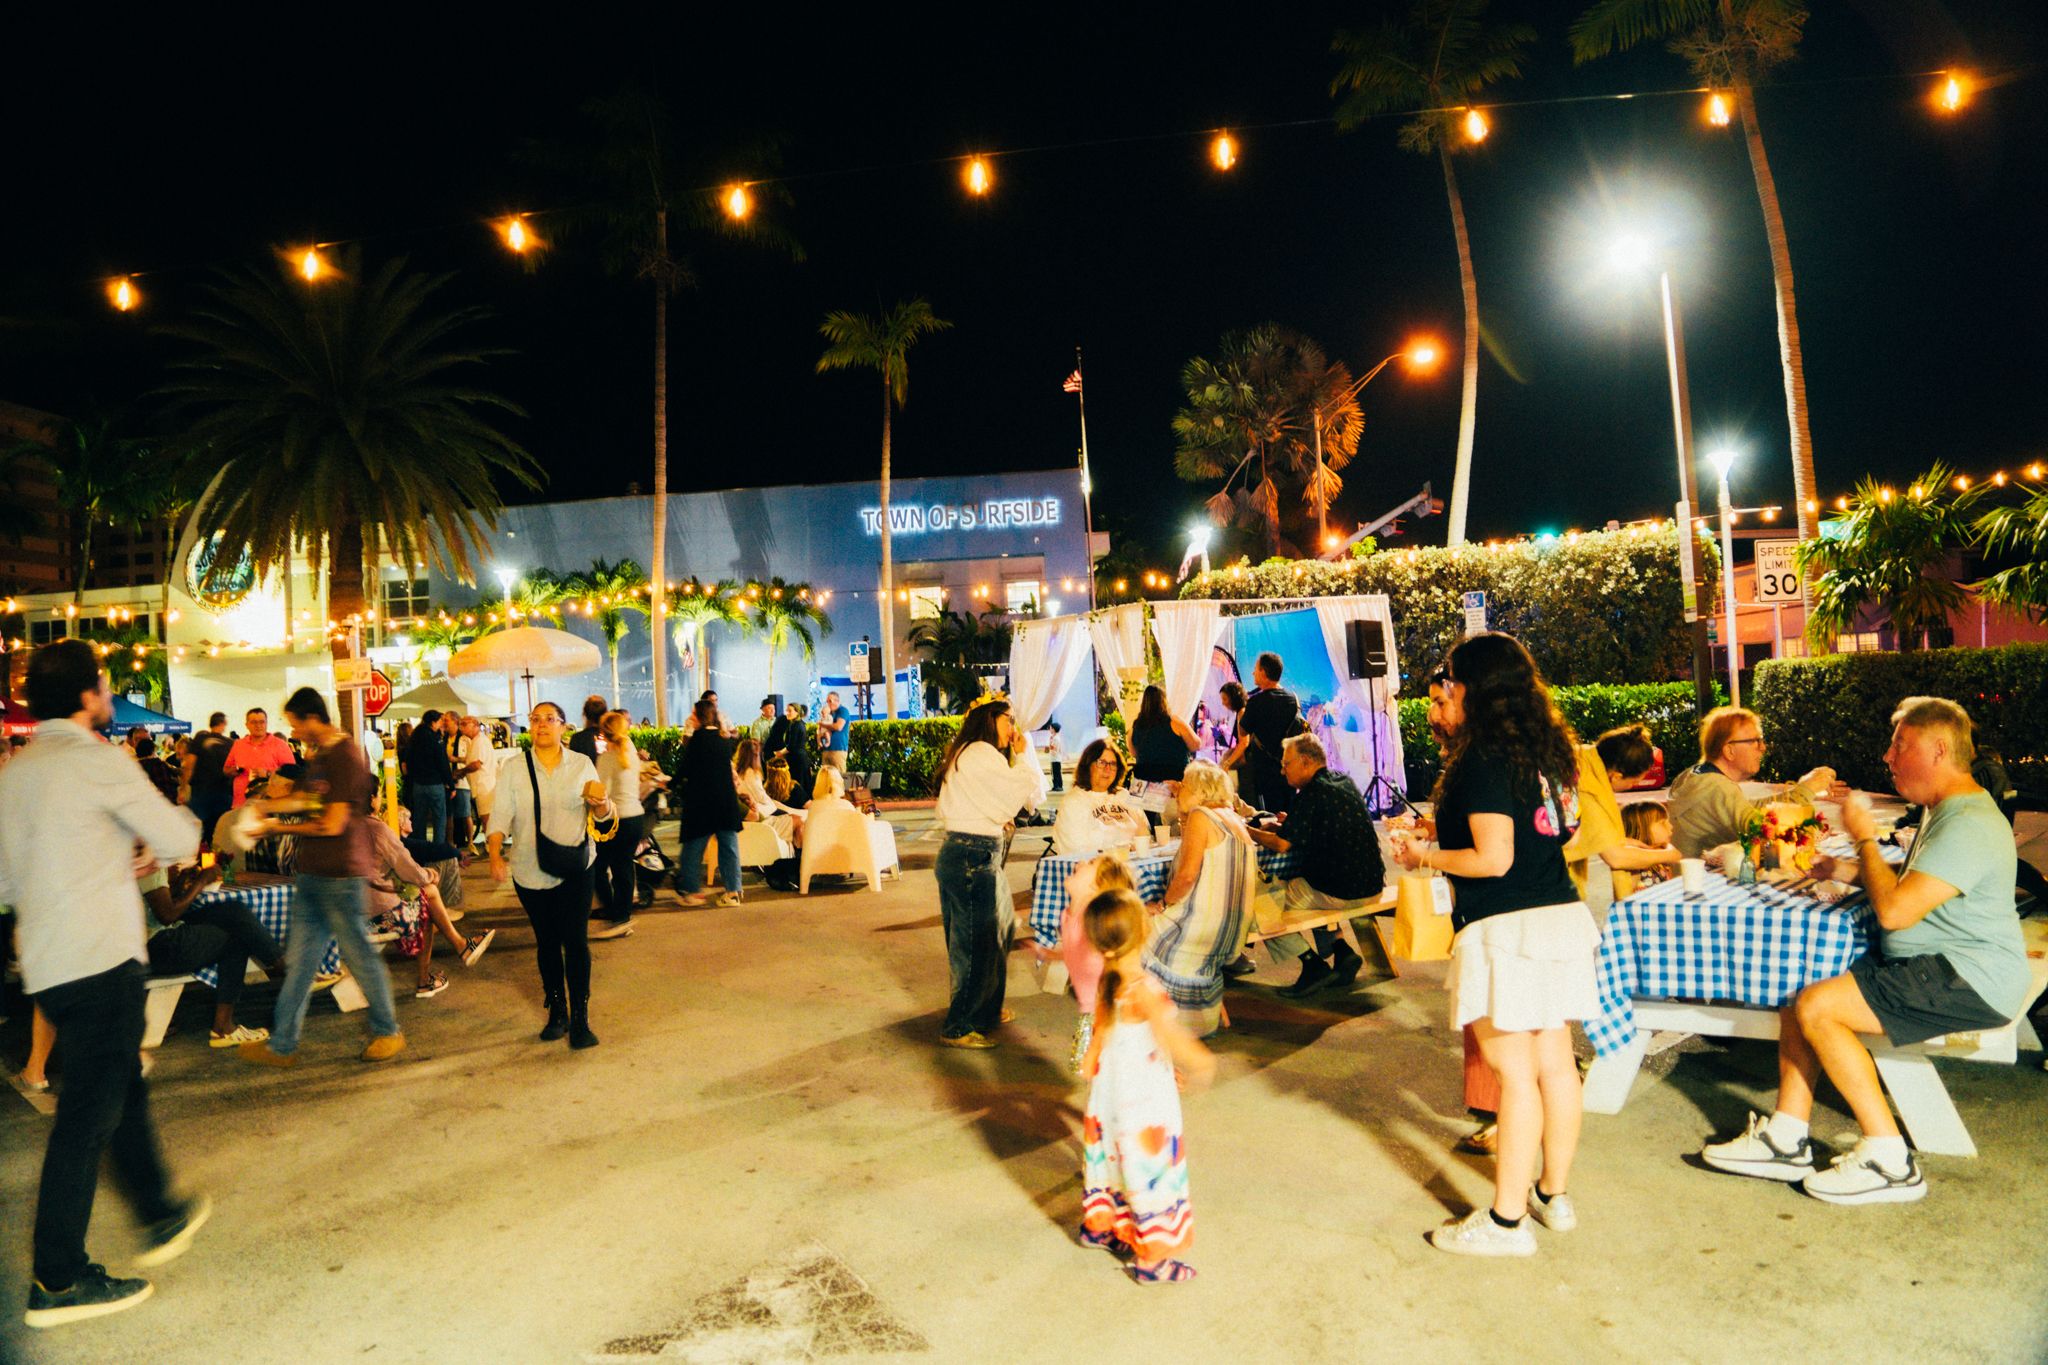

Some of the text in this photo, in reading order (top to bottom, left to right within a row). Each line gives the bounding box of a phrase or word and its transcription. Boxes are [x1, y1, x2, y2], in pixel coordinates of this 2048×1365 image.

[929, 505, 957, 527] OF
[961, 501, 1056, 525] SURFSIDE
[1765, 560, 1793, 569] LIMIT
[1764, 574, 1798, 595] 30
[366, 685, 387, 701] OP
